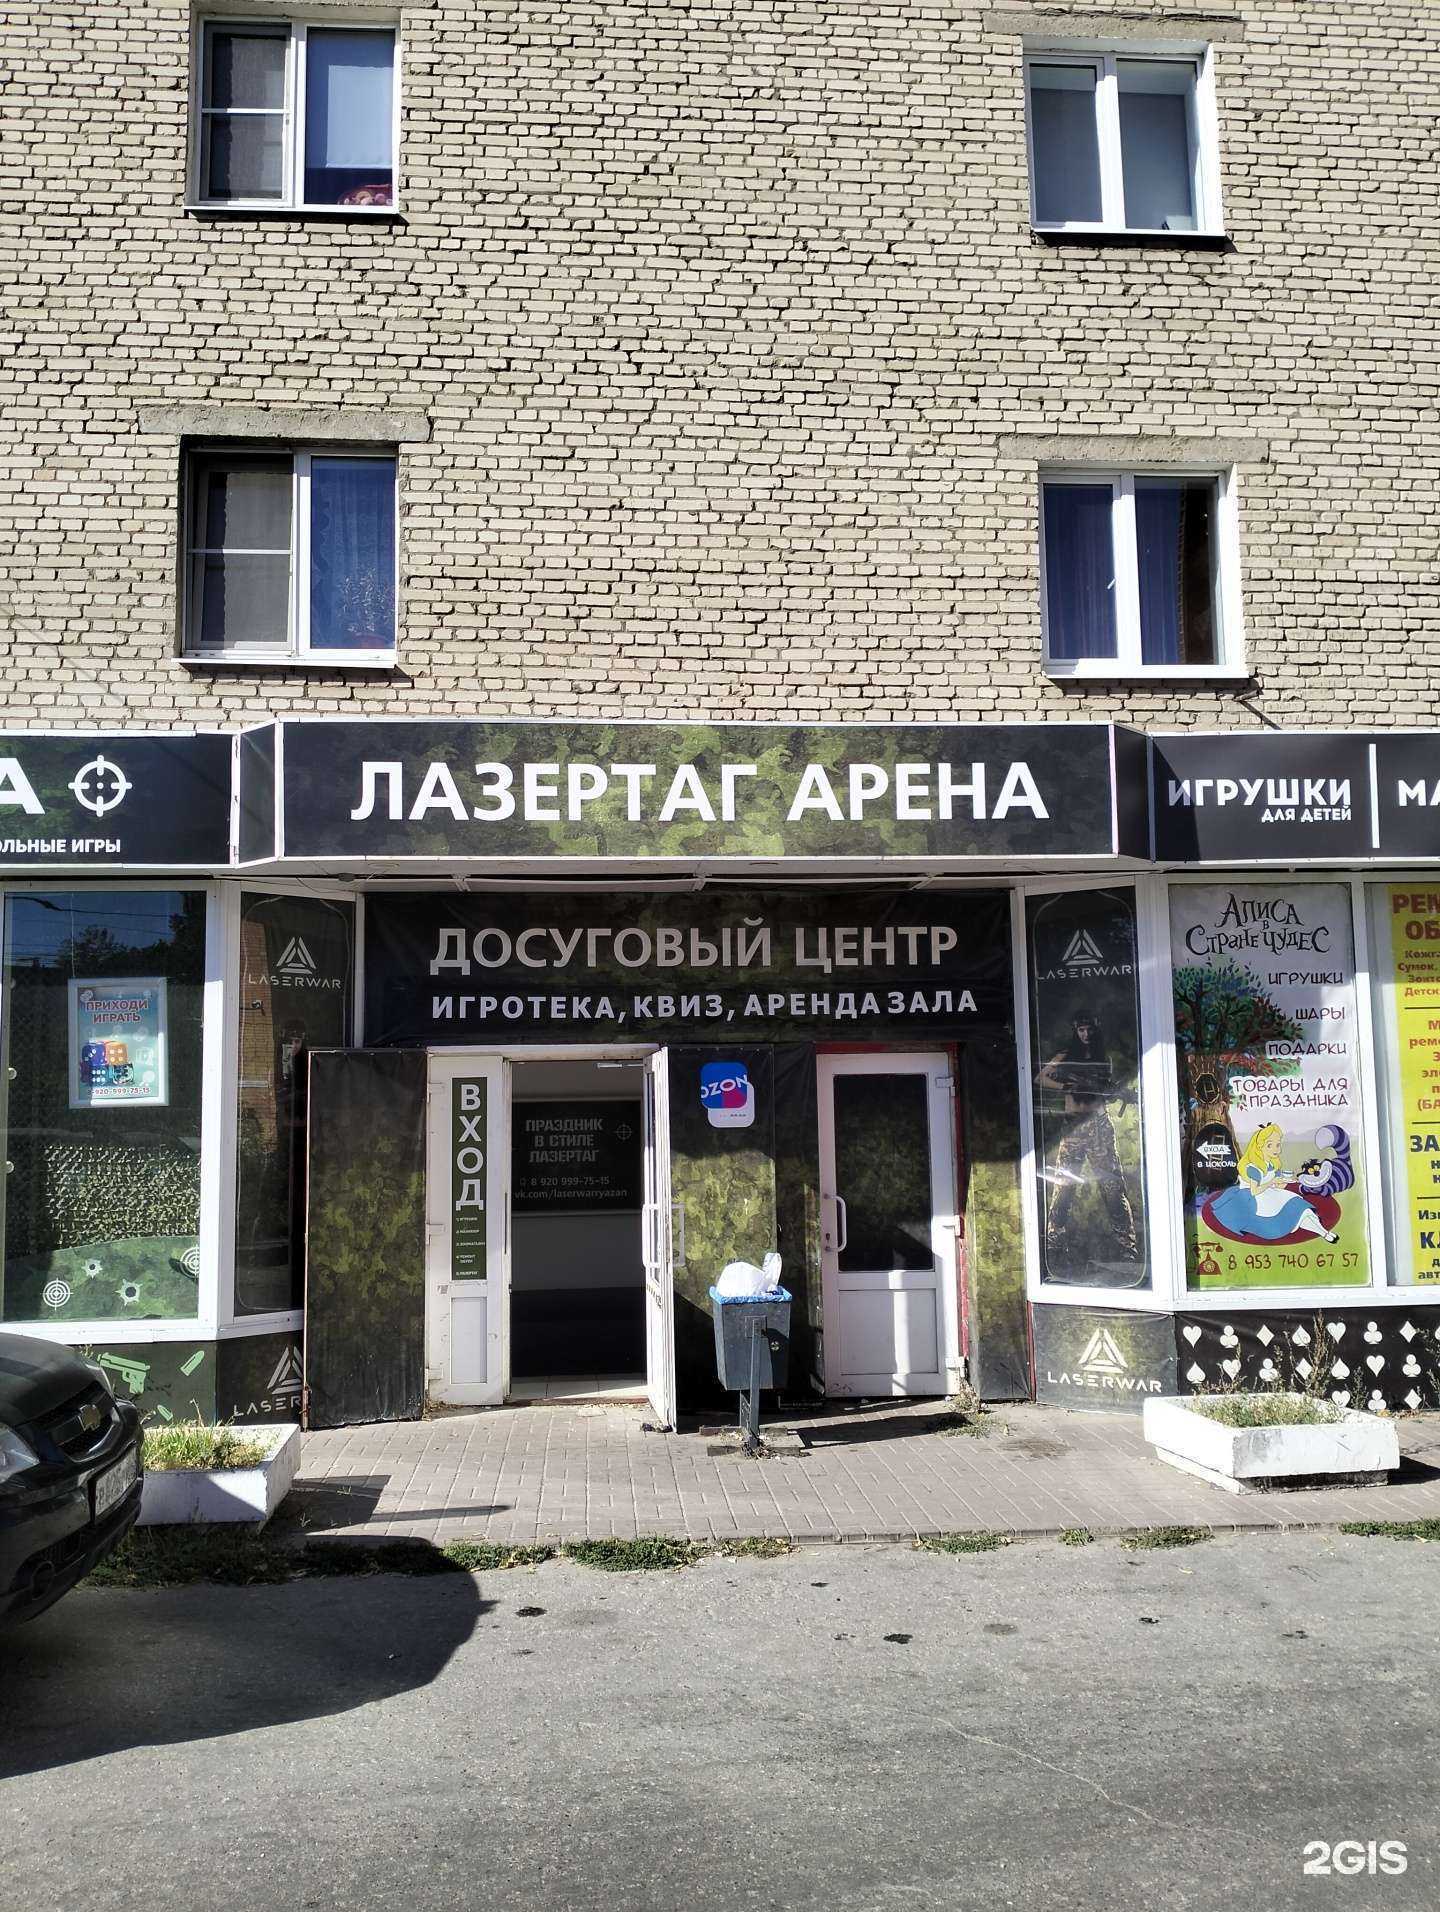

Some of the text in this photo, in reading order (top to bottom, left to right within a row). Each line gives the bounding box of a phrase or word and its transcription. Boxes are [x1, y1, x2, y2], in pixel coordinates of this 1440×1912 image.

[350, 761, 1049, 822] ЛАЗЕРТАГ АРЕНА
[1168, 779, 1351, 806] ИГРУШКИ
[1261, 804, 1352, 823] ДЛЯ ДЕТЕЙ
[0, 839, 121, 853] ЛЬНЫЕ ИГРЫ
[429, 917, 958, 976] ДОСУГОВЫЙ ЦЕНТР
[1037, 964, 1132, 980] LASERWAR
[1268, 972, 1344, 985] ИГРУШКИ
[248, 973, 342, 989] LASERWAR
[86, 999, 149, 1012] ПРИХОДИ
[432, 990, 978, 1024] ИГРОТЕКА, КВИЗ, АРЕНДА ЗАЛА
[93, 1012, 141, 1024] ИГРАТЬ
[1295, 1007, 1345, 1020] ШАРЫ
[1268, 1043, 1347, 1056] ПОДАРКИ
[701, 1074, 748, 1099] OZON
[1232, 1078, 1348, 1093] ТОВАРЫ ДЛЯ
[1249, 1094, 1349, 1109] ПРАЗДНИКА
[525, 1118, 604, 1132] ПРАЗДНИК
[456, 1084, 484, 1211] ВХОД
[534, 1134, 594, 1147] В СТИЛЕ
[529, 1149, 600, 1163] ЛАЗЕРТАГ
[531, 1175, 610, 1186] 8 920 999-75-15
[1228, 1252, 1359, 1270] 8 953 740 67 57
[1047, 1371, 1162, 1393] LASERWAR
